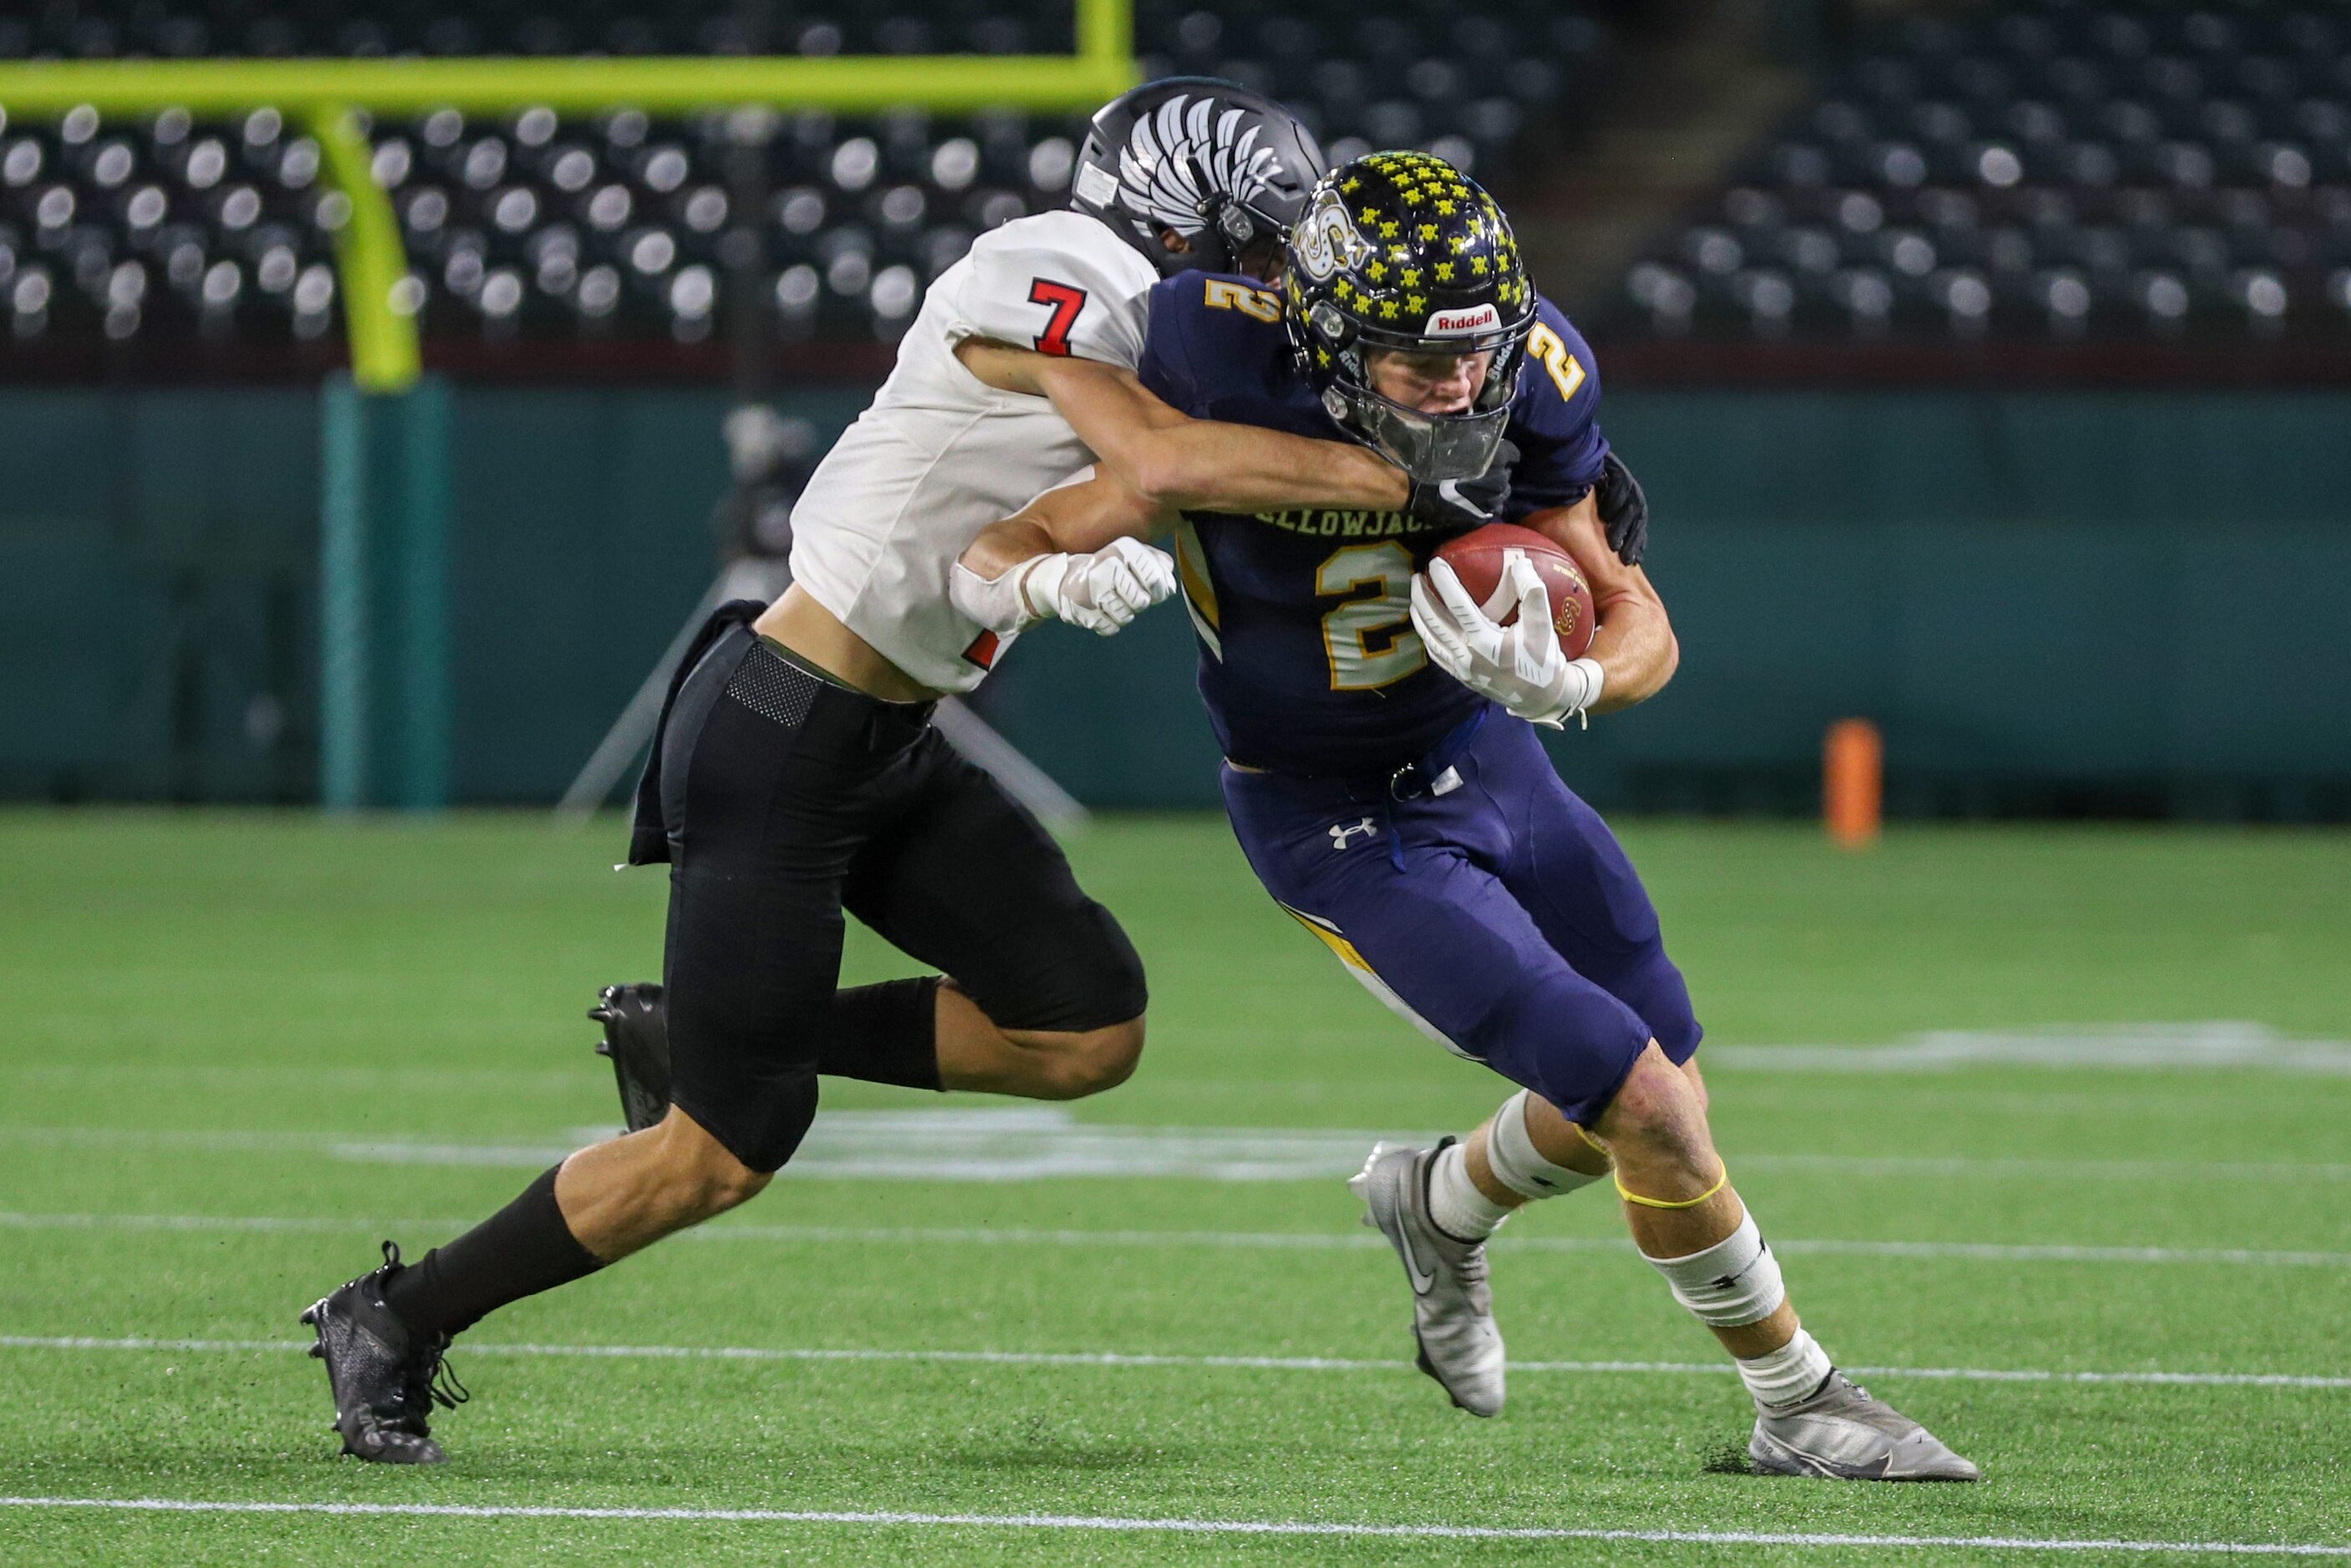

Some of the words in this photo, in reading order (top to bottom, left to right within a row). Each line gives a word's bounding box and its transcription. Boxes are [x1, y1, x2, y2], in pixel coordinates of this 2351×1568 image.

[1027, 276, 1088, 357] 7
[1205, 279, 1281, 321] 2
[1438, 310, 1493, 330] Riddell
[1528, 321, 1585, 402] 2
[1315, 539, 1428, 691] 2
